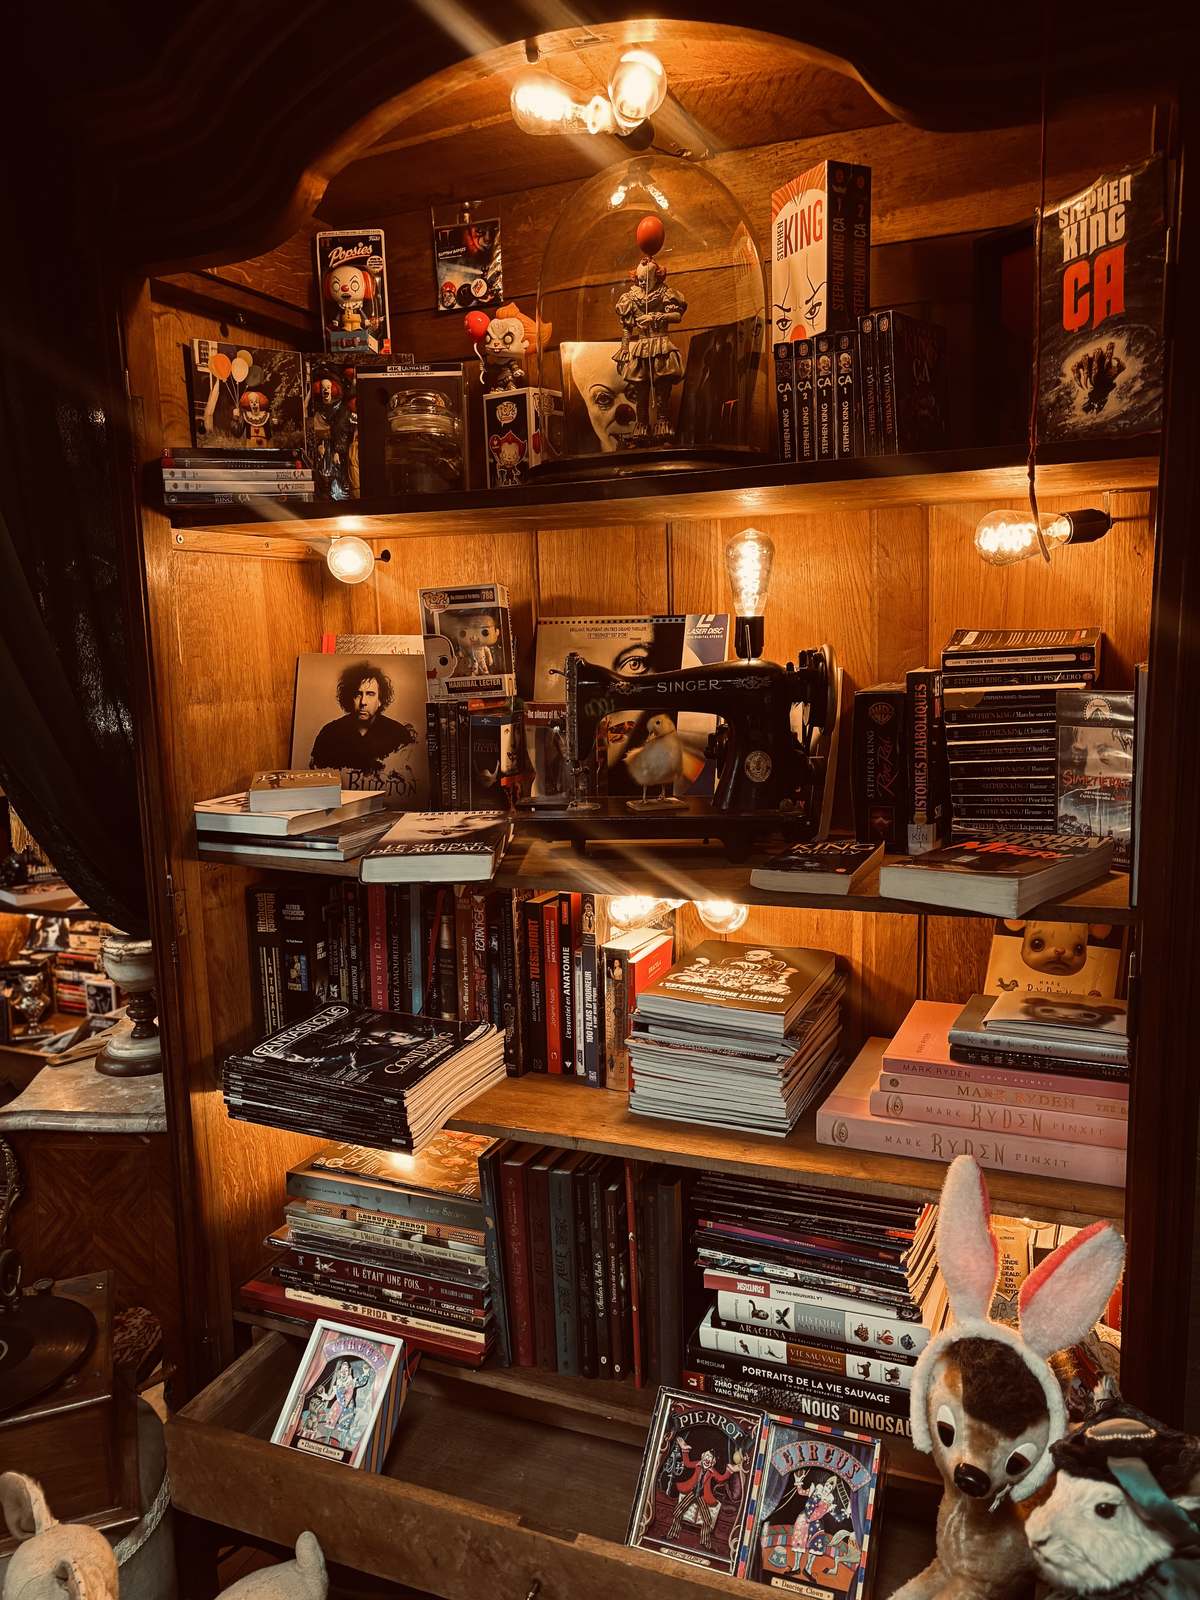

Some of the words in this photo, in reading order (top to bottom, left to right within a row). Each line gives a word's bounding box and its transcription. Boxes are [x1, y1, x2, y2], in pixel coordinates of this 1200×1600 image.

[1058, 174, 1132, 229] STEPHEN
[776, 220, 784, 261] STEPHEN
[784, 199, 823, 258] KING
[1063, 204, 1126, 262] KING
[328, 242, 373, 268] Popsies
[777, 382, 792, 394] ÇA
[797, 380, 812, 392] ÇA
[817, 377, 832, 389] ÇA
[837, 375, 853, 387] ÇA
[783, 424, 792, 459] STEPHEN
[803, 422, 811, 457] STEPHEN
[821, 419, 829, 454] STEPHEN
[842, 418, 850, 453] STEPHEN
[479, 678, 501, 686] LECTER
[657, 679, 722, 694] SINGER
[914, 683, 928, 760] DIABOLIQUES
[562, 946, 571, 995] ANATOMIE
[584, 971, 593, 1008] D'HORREUR
[739, 993, 785, 1004] ALLEMAND
[256, 1006, 347, 1056] FANTASTIQUE
[564, 1004, 572, 1039] L'essentiel
[585, 1009, 594, 1029] FILMS
[903, 1063, 931, 1074] MARK
[935, 1067, 971, 1080] RYDEN
[957, 1085, 1006, 1102] MARK
[1013, 1092, 1076, 1110] RYDEN
[926, 1106, 962, 1118] MARK
[1050, 1123, 1105, 1137] PINXIT
[885, 1135, 922, 1148] MARK
[1015, 1156, 1072, 1169] PINXIT
[352, 1266, 360, 1278] IL
[362, 1267, 384, 1283] ÉTAIT
[386, 1274, 401, 1286] UNE
[361, 1306, 388, 1320] FRIDA
[737, 1323, 786, 1341] ARACHNA
[789, 1348, 803, 1359] VIE
[803, 1350, 841, 1365] SAUVAGE
[714, 1379, 733, 1391] ZHAO
[741, 1365, 794, 1384] PORTRAITS
[796, 1376, 809, 1387] DE
[811, 1379, 824, 1390] LA
[826, 1382, 842, 1393] VIE
[844, 1386, 890, 1404] SAUVAGE
[801, 1397, 840, 1421] NOUS
[678, 1410, 743, 1441] PIERROT
[782, 1444, 861, 1480] CIRCUS
[781, 1579, 802, 1594] Dancing
[805, 1585, 824, 1598] Clown
